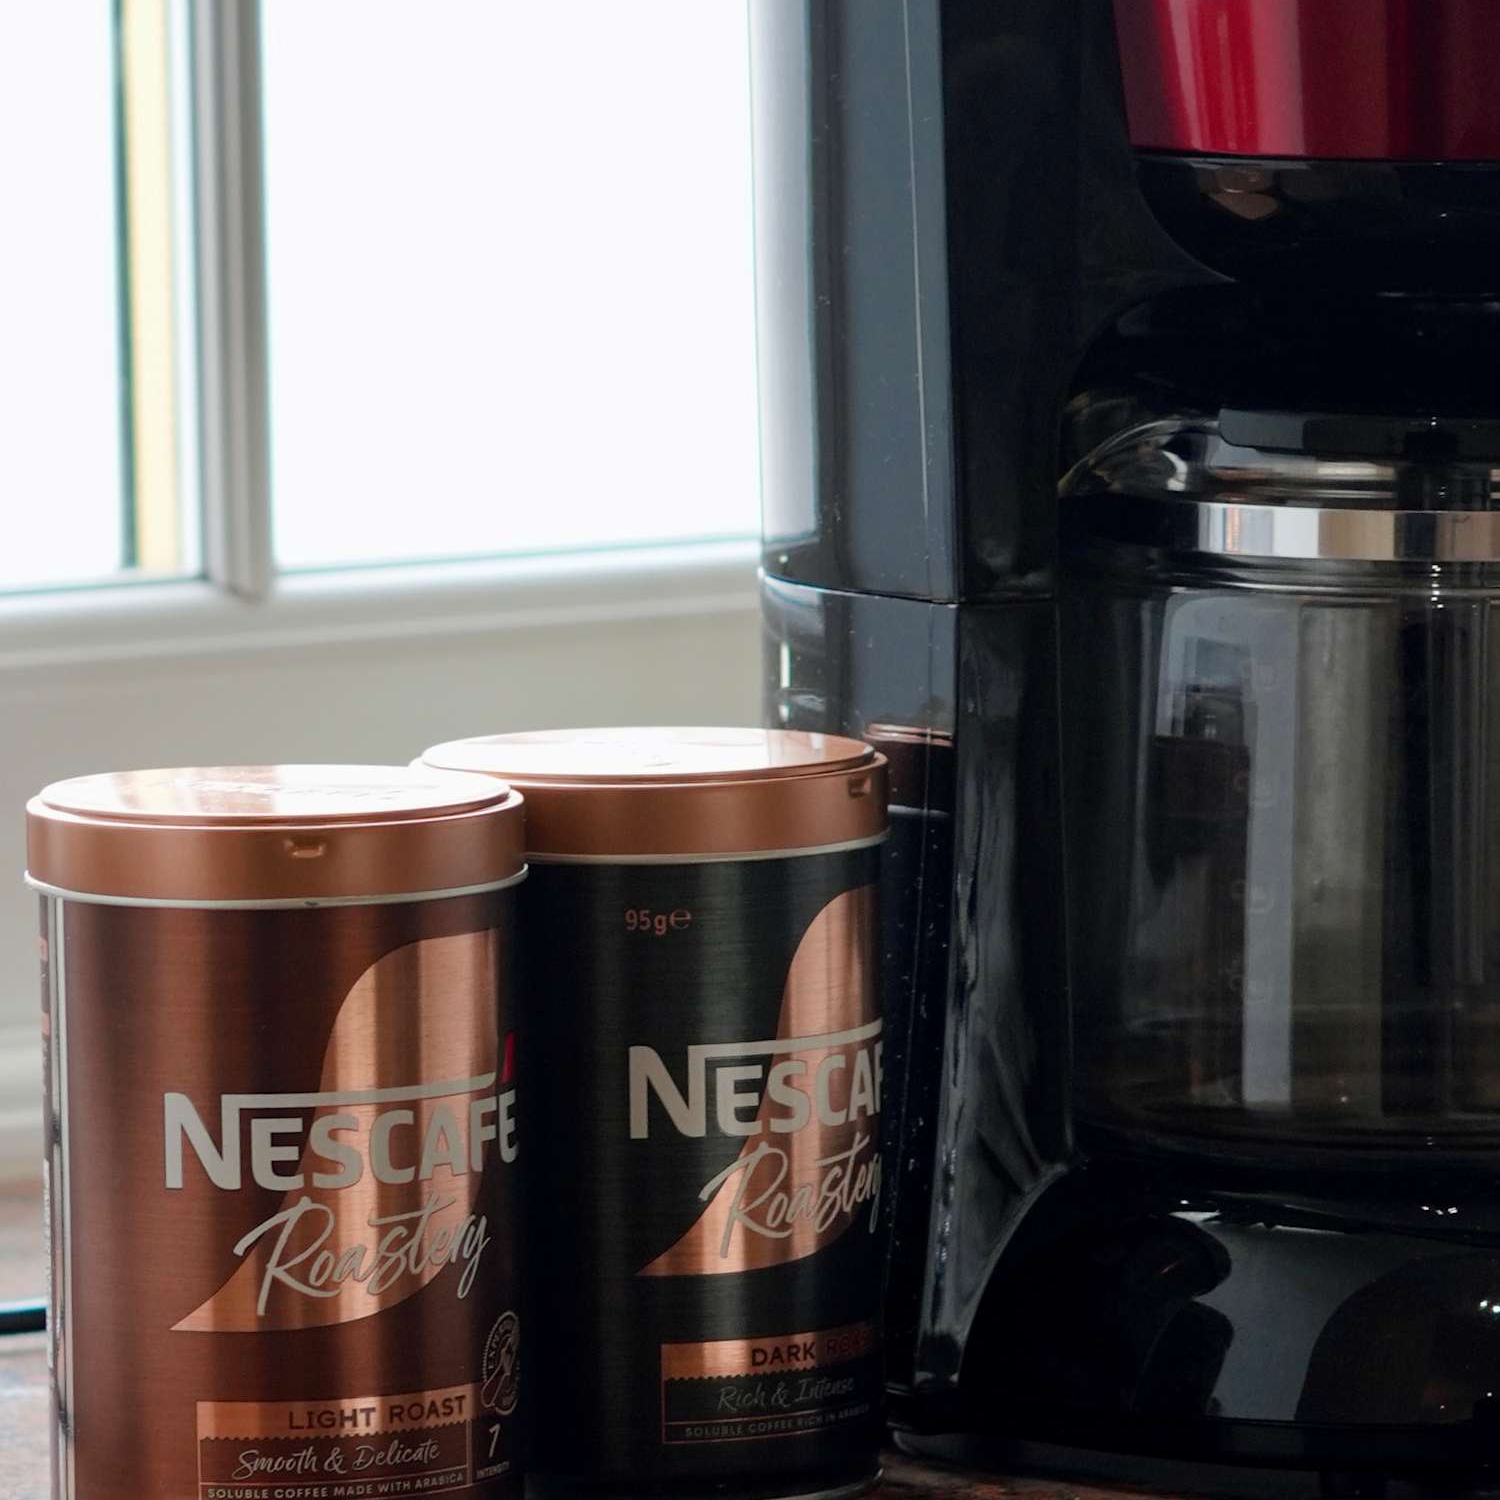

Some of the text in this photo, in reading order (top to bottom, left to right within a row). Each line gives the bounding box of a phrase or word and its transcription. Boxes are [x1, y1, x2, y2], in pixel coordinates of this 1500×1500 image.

[233, 1191, 492, 1316] Roastery
[751, 1341, 816, 1367] DARK
[288, 1394, 467, 1430] LIGHT ROAST
[717, 1381, 767, 1413] Rich
[770, 1381, 791, 1408] &
[685, 1420, 743, 1438] SOLUBLE
[748, 1418, 793, 1434] COFFEE
[232, 1438, 441, 1480] Smooth & Delicate
[207, 1472, 465, 1500] SOLUBLE COFFEE MADE WITH ARABICA
